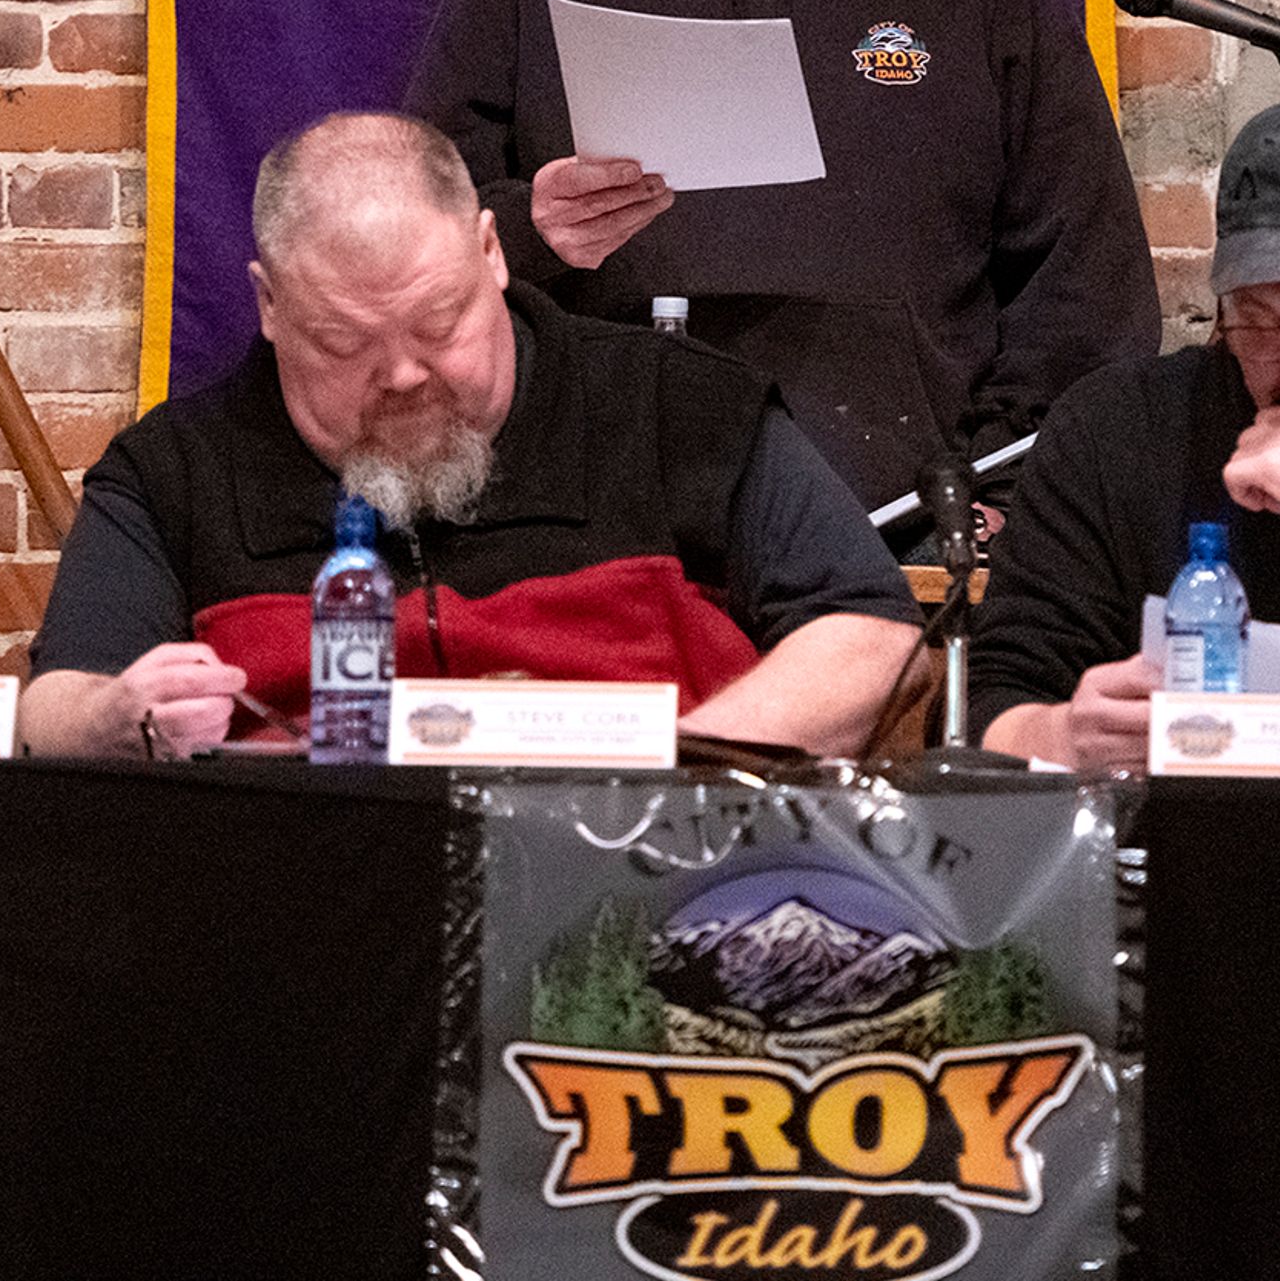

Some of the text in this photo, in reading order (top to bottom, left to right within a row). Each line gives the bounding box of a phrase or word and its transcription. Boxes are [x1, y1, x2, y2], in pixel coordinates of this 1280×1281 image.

[868, 21, 915, 35] CITY OF
[860, 51, 926, 69] TROY
[875, 69, 914, 80] IDAHO
[506, 710, 566, 724] STEVE
[527, 1054, 1074, 1190] TROY
[677, 1198, 926, 1269] Idaho
